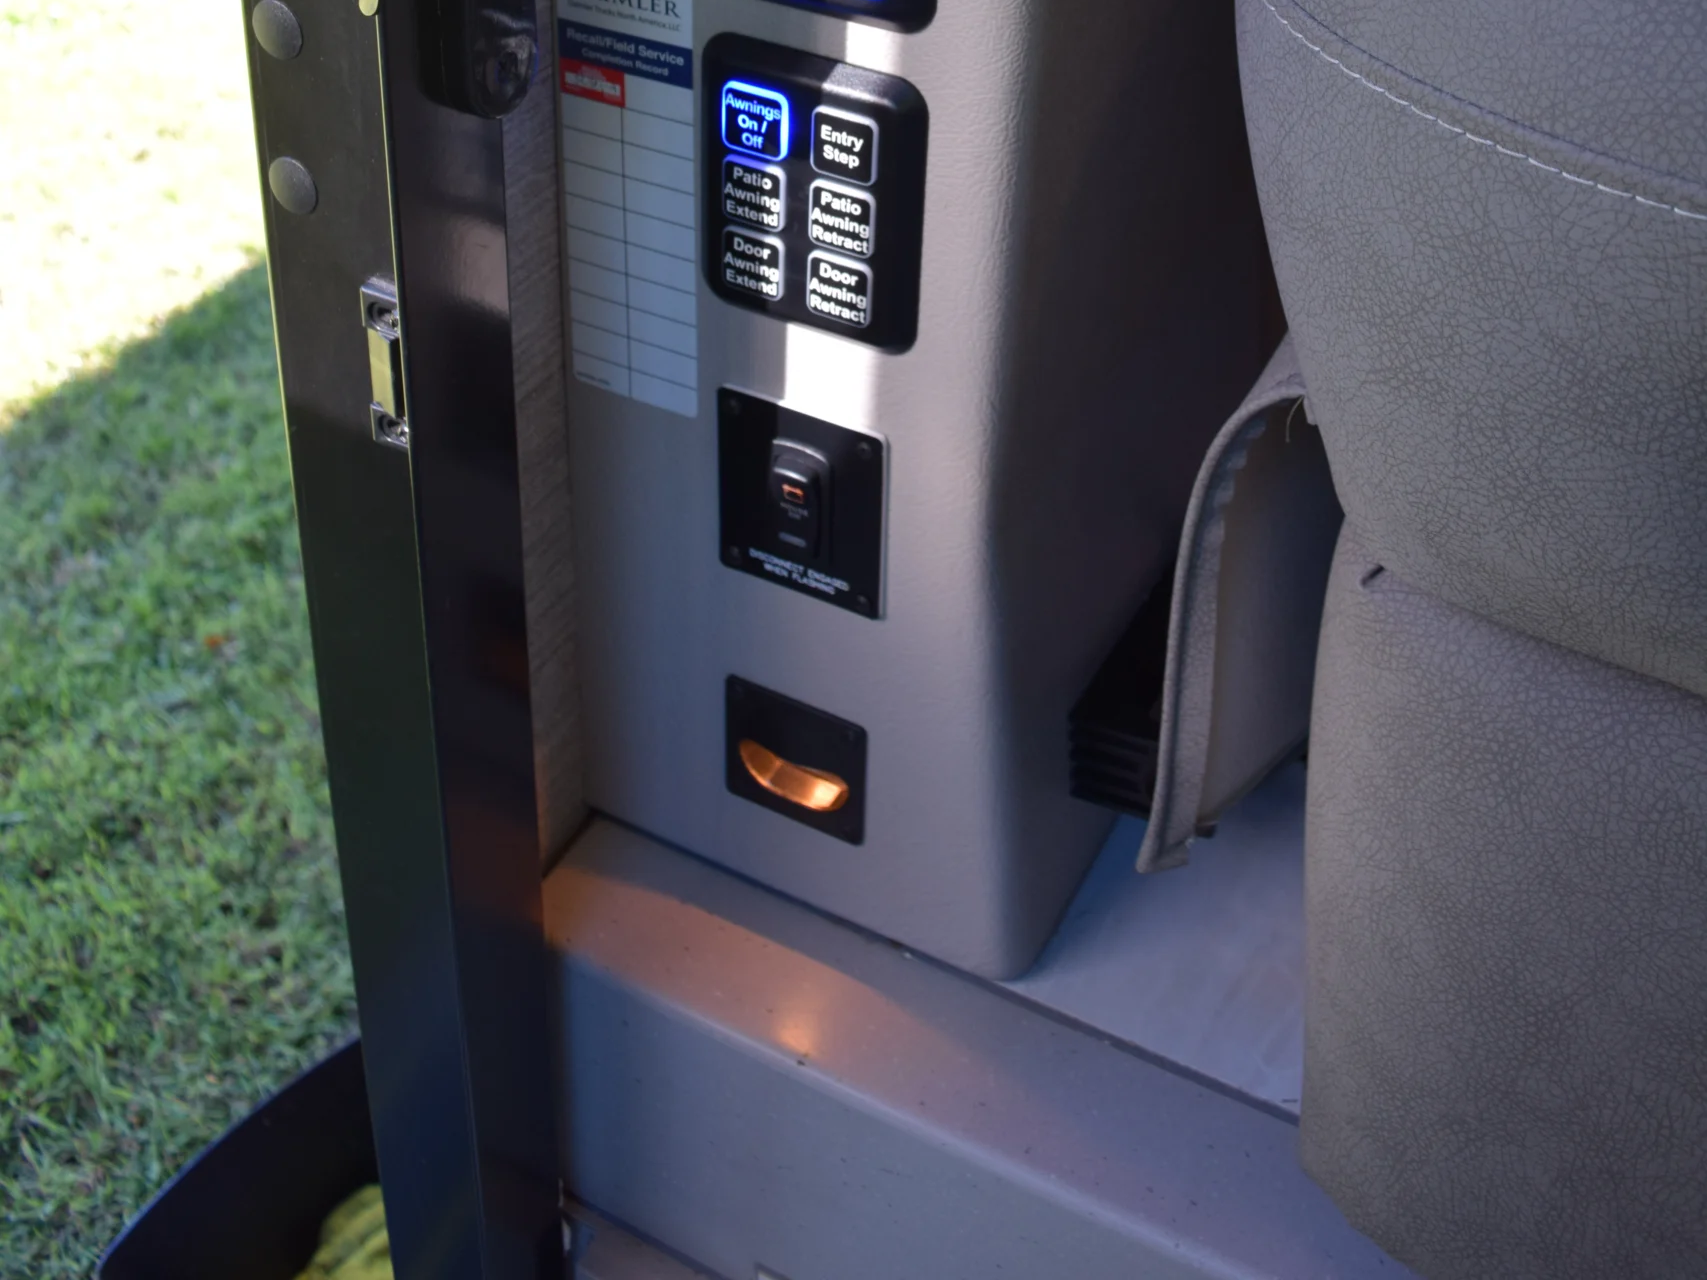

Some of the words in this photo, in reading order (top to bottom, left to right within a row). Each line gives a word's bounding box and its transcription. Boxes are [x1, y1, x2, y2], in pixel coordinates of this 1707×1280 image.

[566, 27, 635, 54] Recall/Field
[638, 44, 684, 66] Service
[581, 48, 633, 68] Completion
[635, 60, 669, 76] Record
[725, 93, 781, 120] Awnings
[738, 114, 758, 130] On
[761, 120, 768, 134] /
[742, 133, 764, 149] Off
[821, 125, 864, 151] Entry
[823, 146, 860, 169] Step
[733, 167, 772, 189] Patio
[724, 184, 780, 213] Awning
[821, 191, 862, 215] Patio
[726, 201, 779, 227] Extend
[811, 208, 870, 238] Awning
[733, 237, 771, 259] Door
[812, 225, 869, 254] Retract
[724, 253, 779, 282] Awning
[819, 263, 858, 286] Door
[726, 270, 777, 296] Extend
[809, 279, 867, 308] Awning
[810, 296, 865, 324] Retract
[749, 547, 804, 572] DISCONNECT
